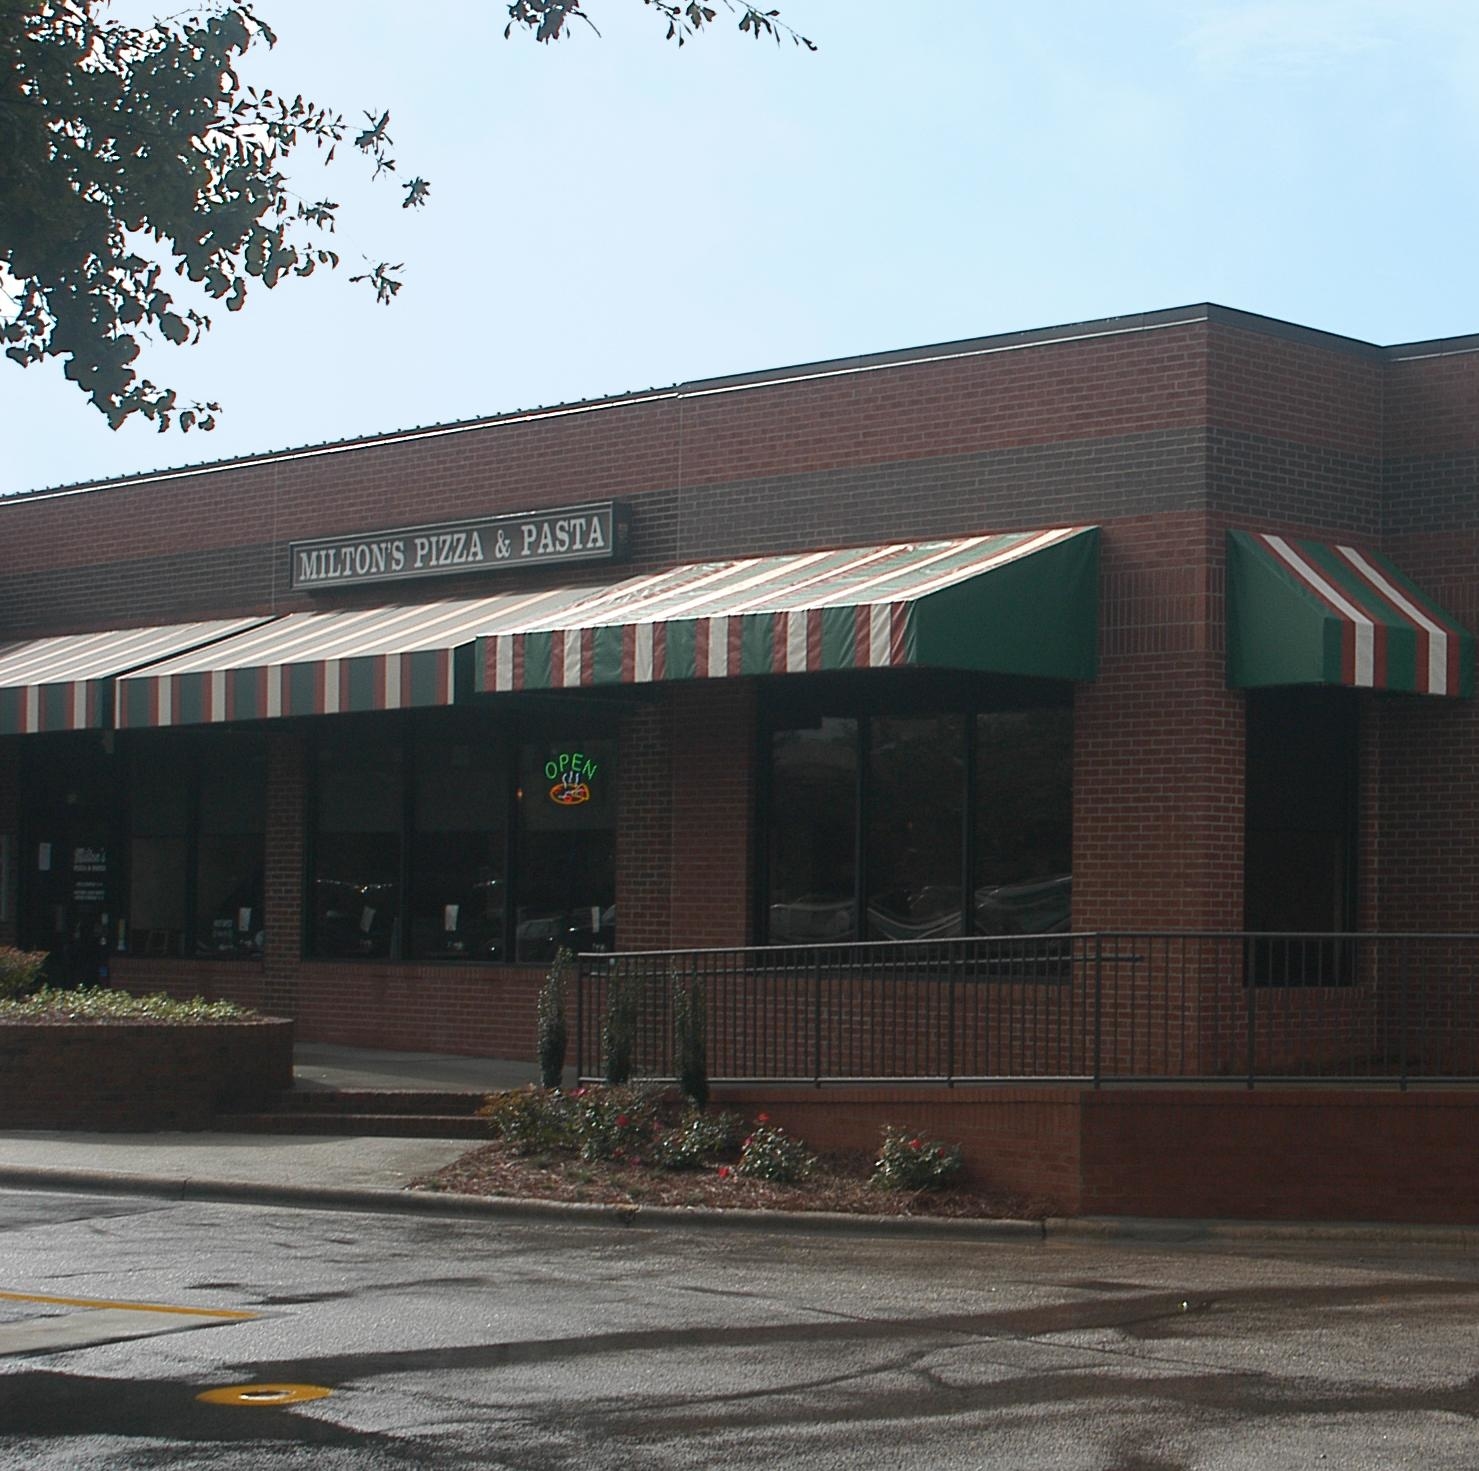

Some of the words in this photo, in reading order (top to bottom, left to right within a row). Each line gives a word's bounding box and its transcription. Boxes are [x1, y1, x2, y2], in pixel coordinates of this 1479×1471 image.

[299, 541, 405, 581] MILTON'S
[414, 531, 484, 568] PIZZA
[495, 529, 512, 559] &
[521, 516, 605, 555] PASTA
[545, 753, 598, 780] OPEN
